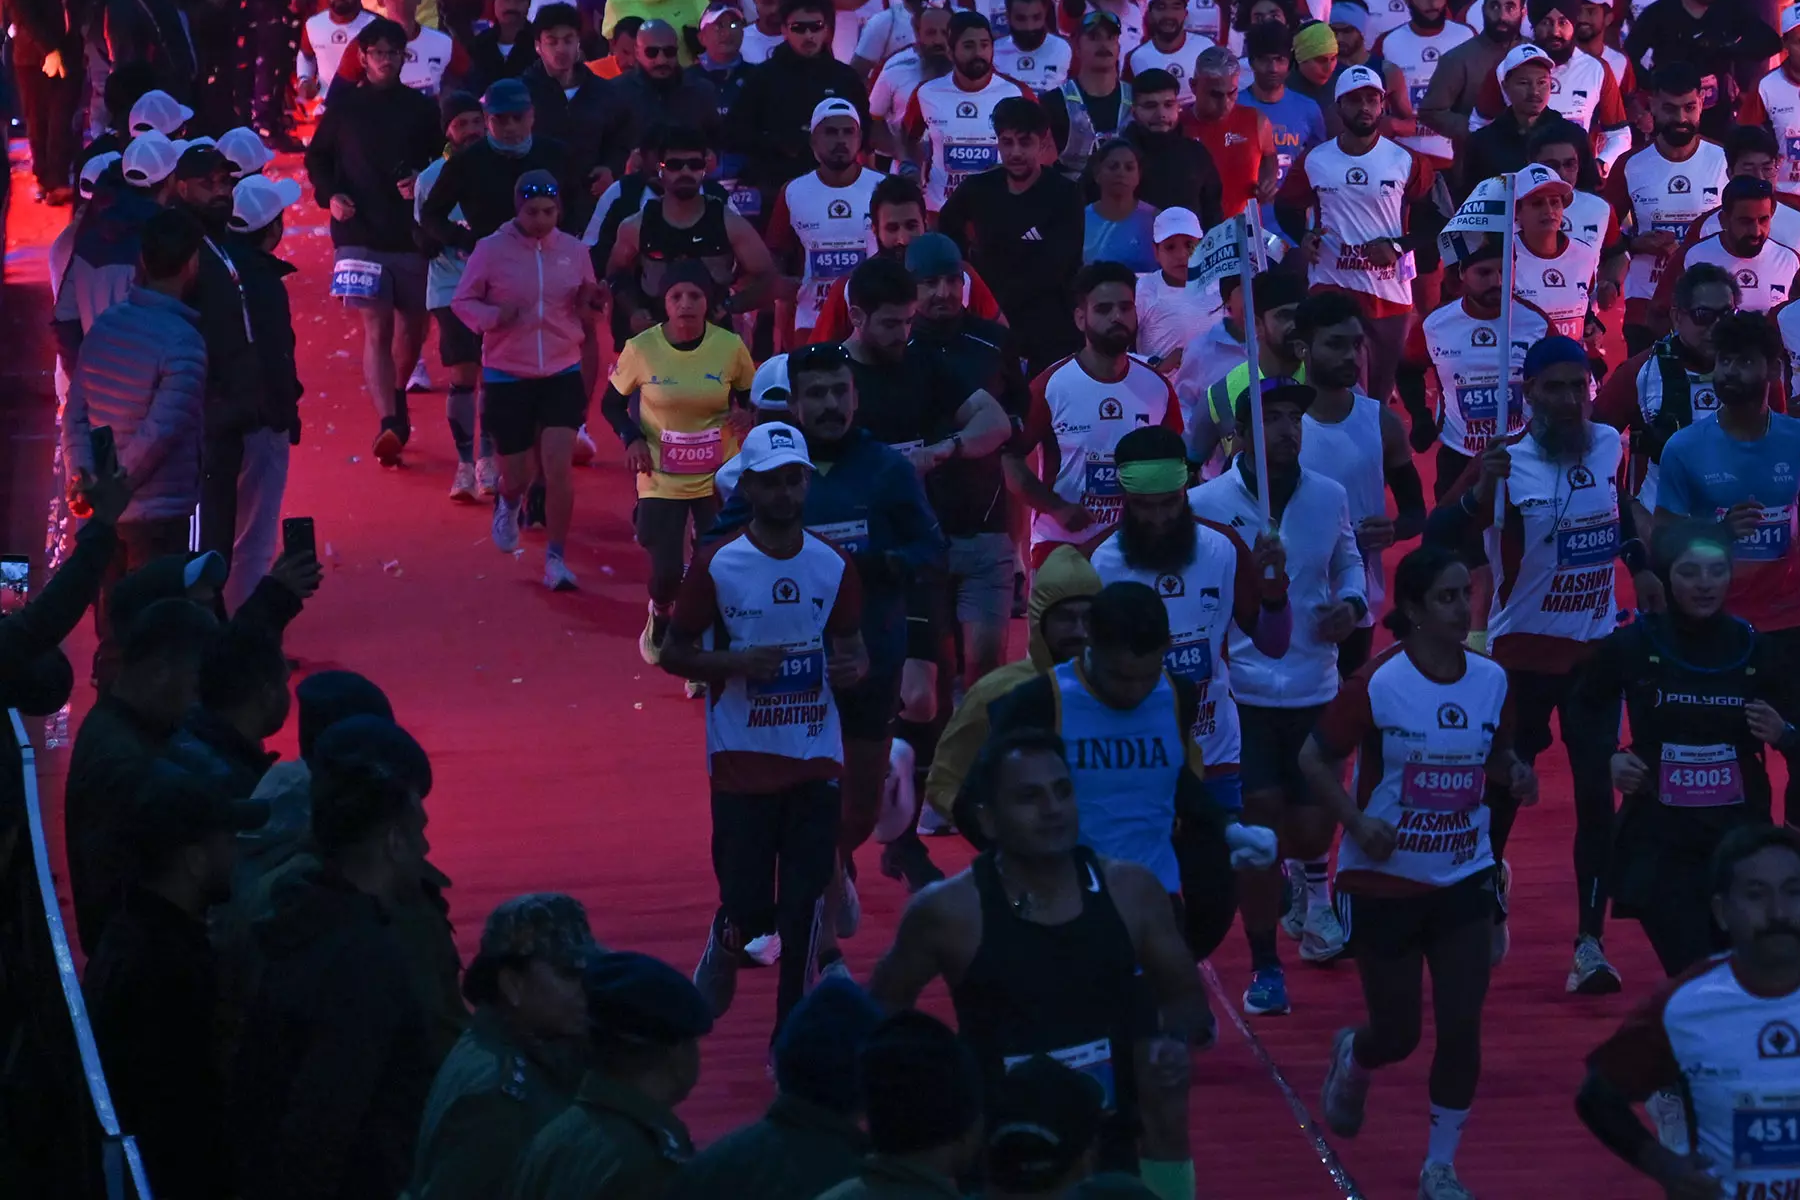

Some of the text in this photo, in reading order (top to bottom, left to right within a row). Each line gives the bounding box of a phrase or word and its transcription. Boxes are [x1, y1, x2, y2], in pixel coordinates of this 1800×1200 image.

[1274, 133, 1300, 147] UN
[949, 147, 991, 160] 45020
[732, 191, 752, 203] 072
[1463, 201, 1486, 214] KM
[1456, 216, 1489, 226] PACER
[816, 252, 859, 266] 45159
[667, 447, 714, 462] 47005
[1566, 527, 1615, 550] 42086
[1738, 527, 1782, 544] 011
[1165, 647, 1202, 670] 148
[778, 657, 811, 677] 191
[1076, 736, 1169, 771] INDIA
[1413, 771, 1473, 790] 43006
[1669, 767, 1732, 787] 43003
